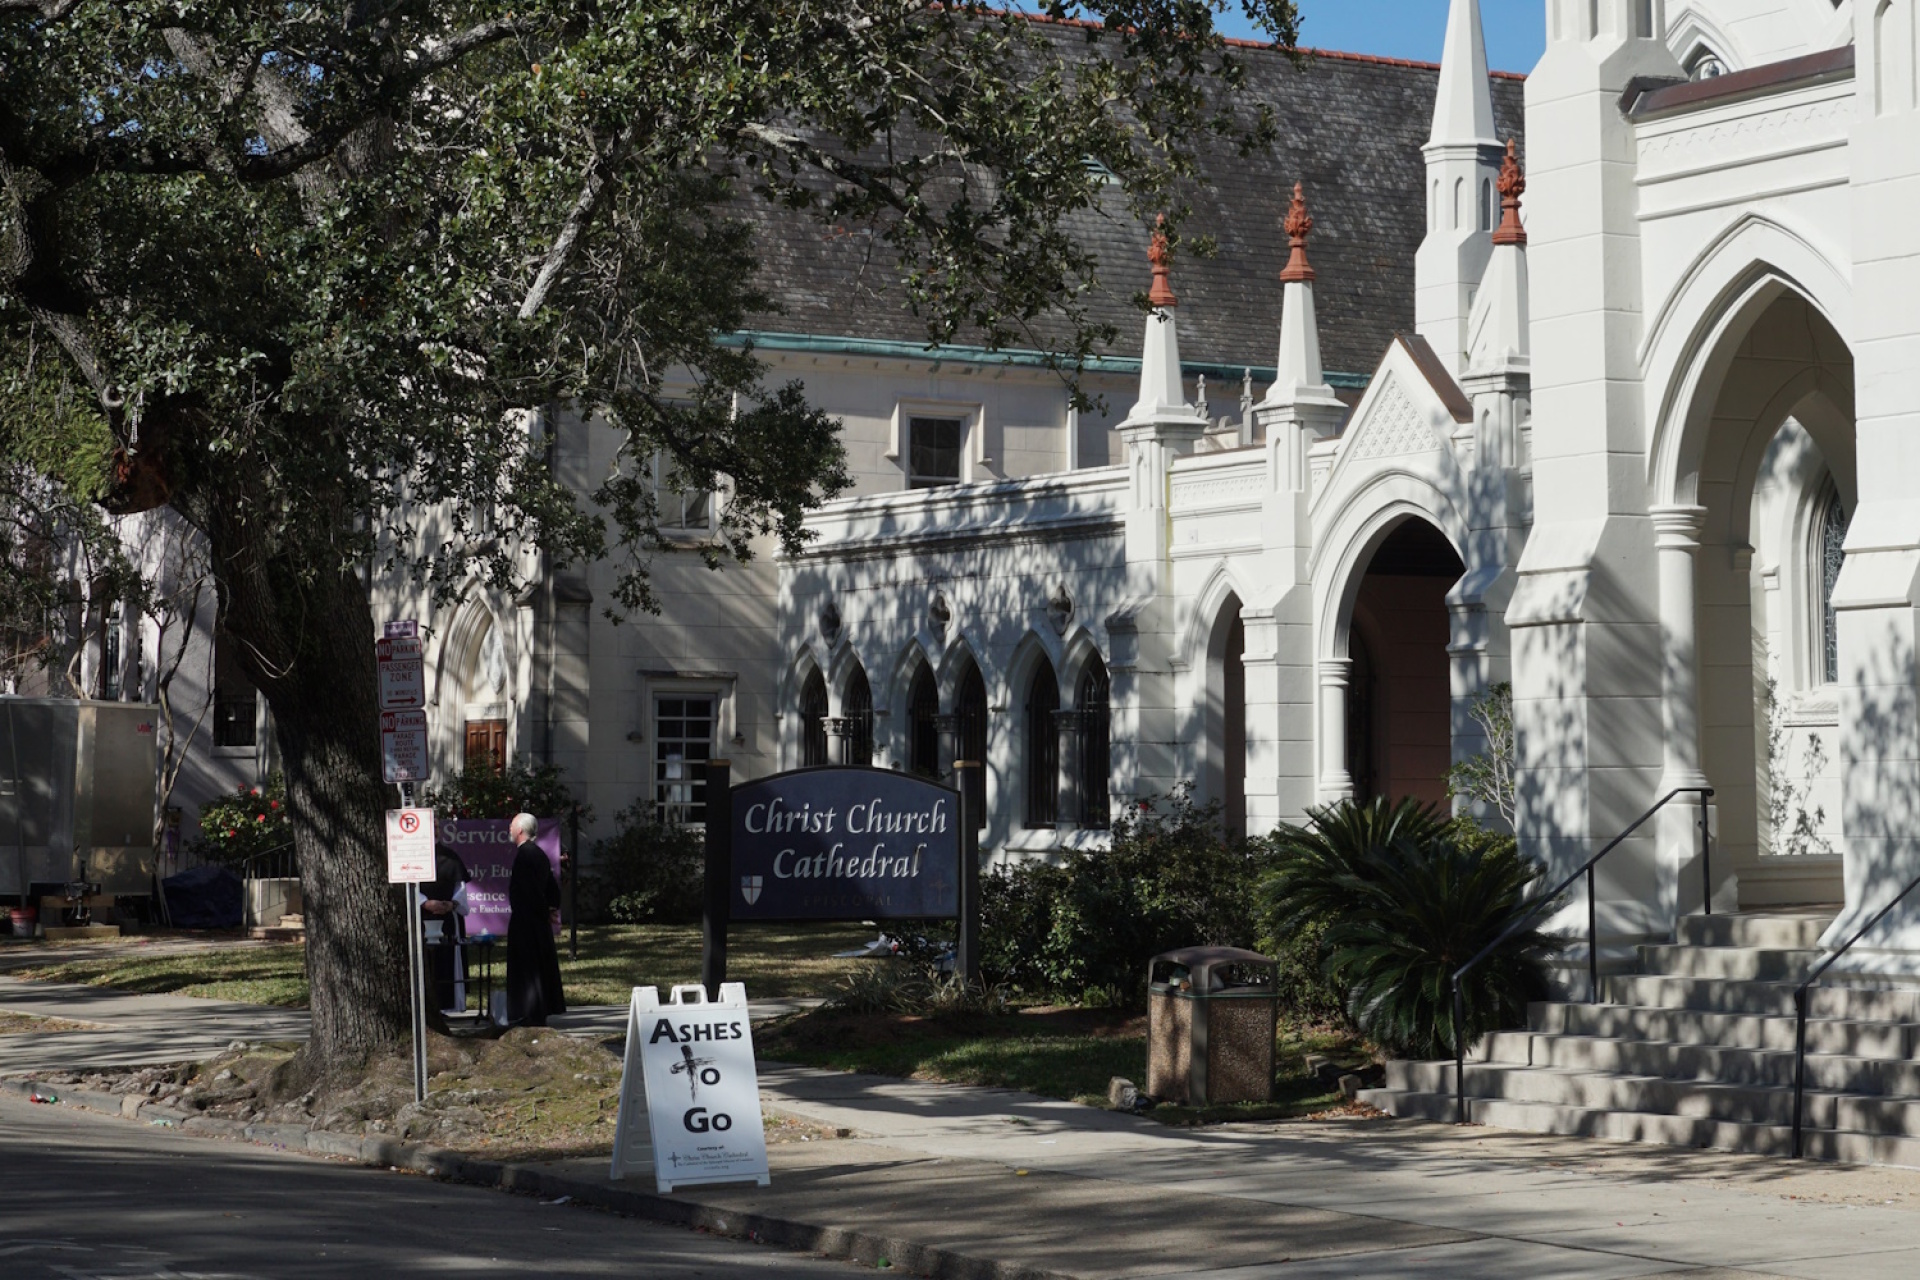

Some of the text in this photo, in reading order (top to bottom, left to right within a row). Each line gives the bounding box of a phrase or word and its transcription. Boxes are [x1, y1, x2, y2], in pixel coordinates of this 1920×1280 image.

[379, 643, 420, 656] NO PARKING
[381, 662, 420, 672] PASSENGER
[390, 672, 413, 682] ZONE
[382, 716, 425, 729] NO PARKING
[744, 797, 947, 834] Christ Church
[773, 842, 928, 879] Cathedral
[467, 864, 488, 882] oly
[479, 904, 512, 914] Euchari
